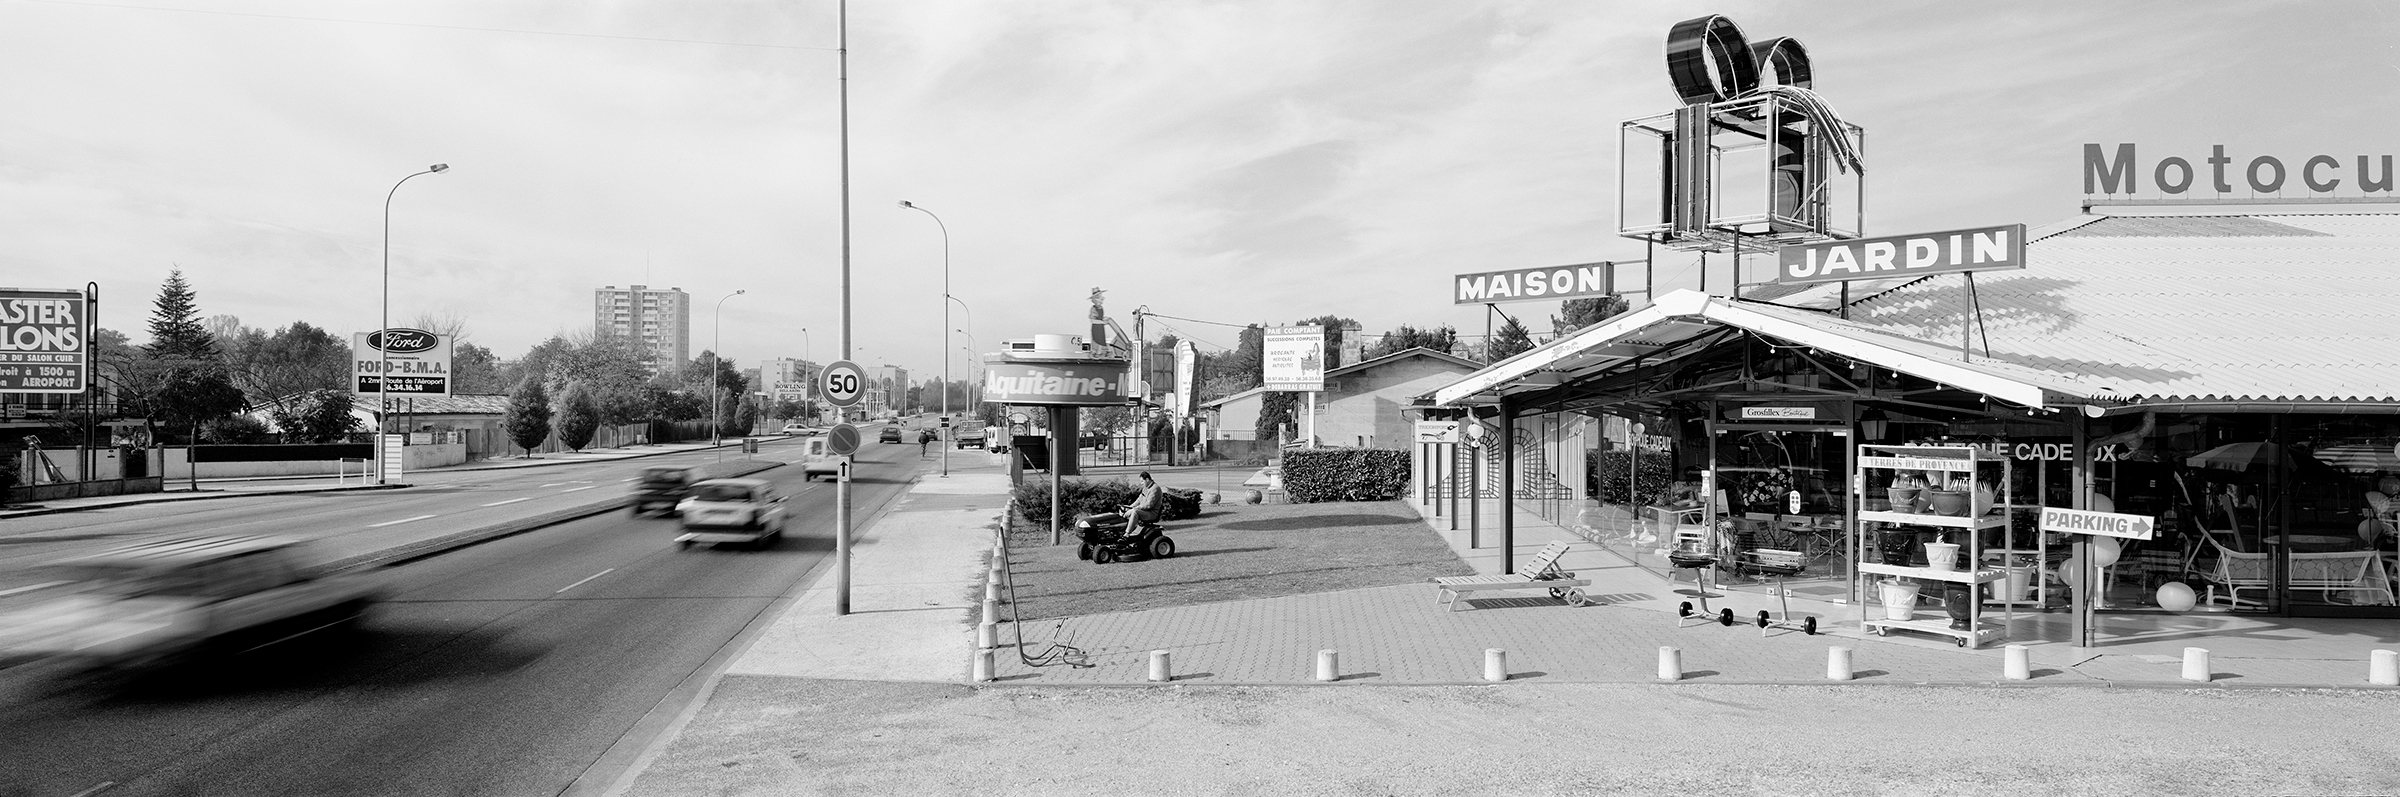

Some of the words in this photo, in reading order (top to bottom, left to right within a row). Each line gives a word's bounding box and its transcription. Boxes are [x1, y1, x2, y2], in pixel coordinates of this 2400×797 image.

[2084, 143, 2393, 194] Motocu
[1789, 231, 2007, 277] JARDIN
[1459, 267, 1600, 300] MAISON
[386, 332, 424, 348] Ford
[27, 354, 52, 362] SALON
[25, 366, 32, 376] à
[39, 367, 63, 376] 1500
[22, 377, 75, 387] AEROPORT
[830, 374, 857, 393] 50
[1747, 408, 1780, 416] Grosfillex
[1870, 458, 1902, 466] TERRES
[1905, 460, 1918, 468] DE
[1921, 460, 1965, 470] PROVENCE
[2045, 511, 2128, 534] PARKING
